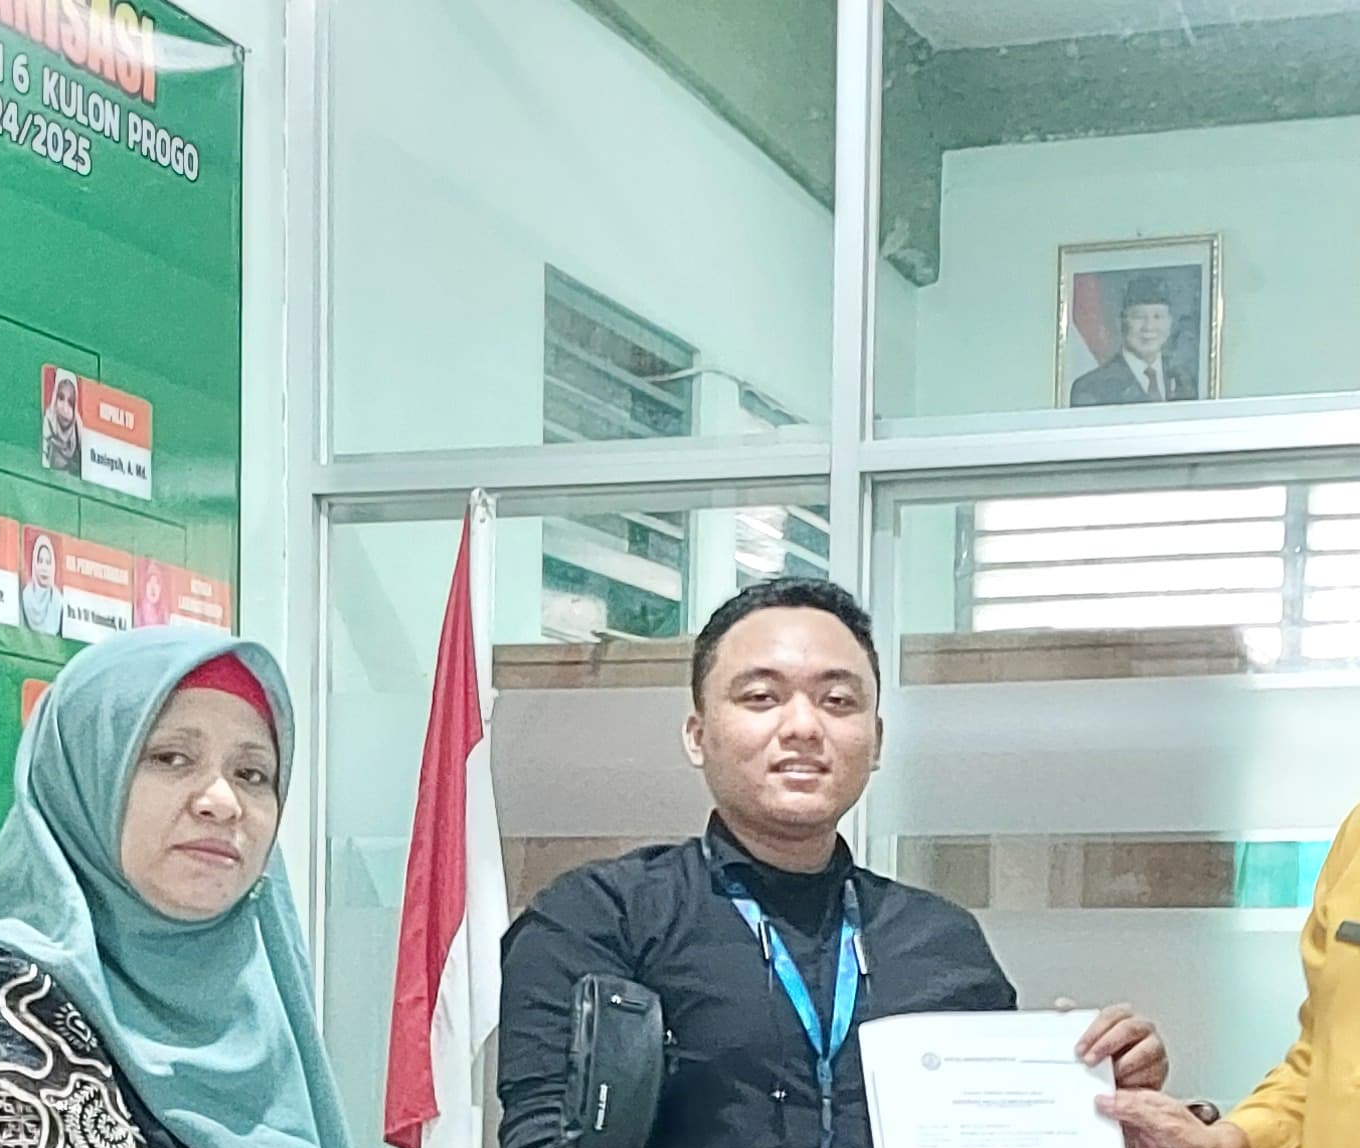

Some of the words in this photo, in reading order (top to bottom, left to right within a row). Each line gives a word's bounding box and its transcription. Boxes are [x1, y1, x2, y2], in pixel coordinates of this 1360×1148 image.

[12, 54, 30, 94] 6
[43, 67, 120, 142] KULON
[128, 112, 199, 181] PROGO
